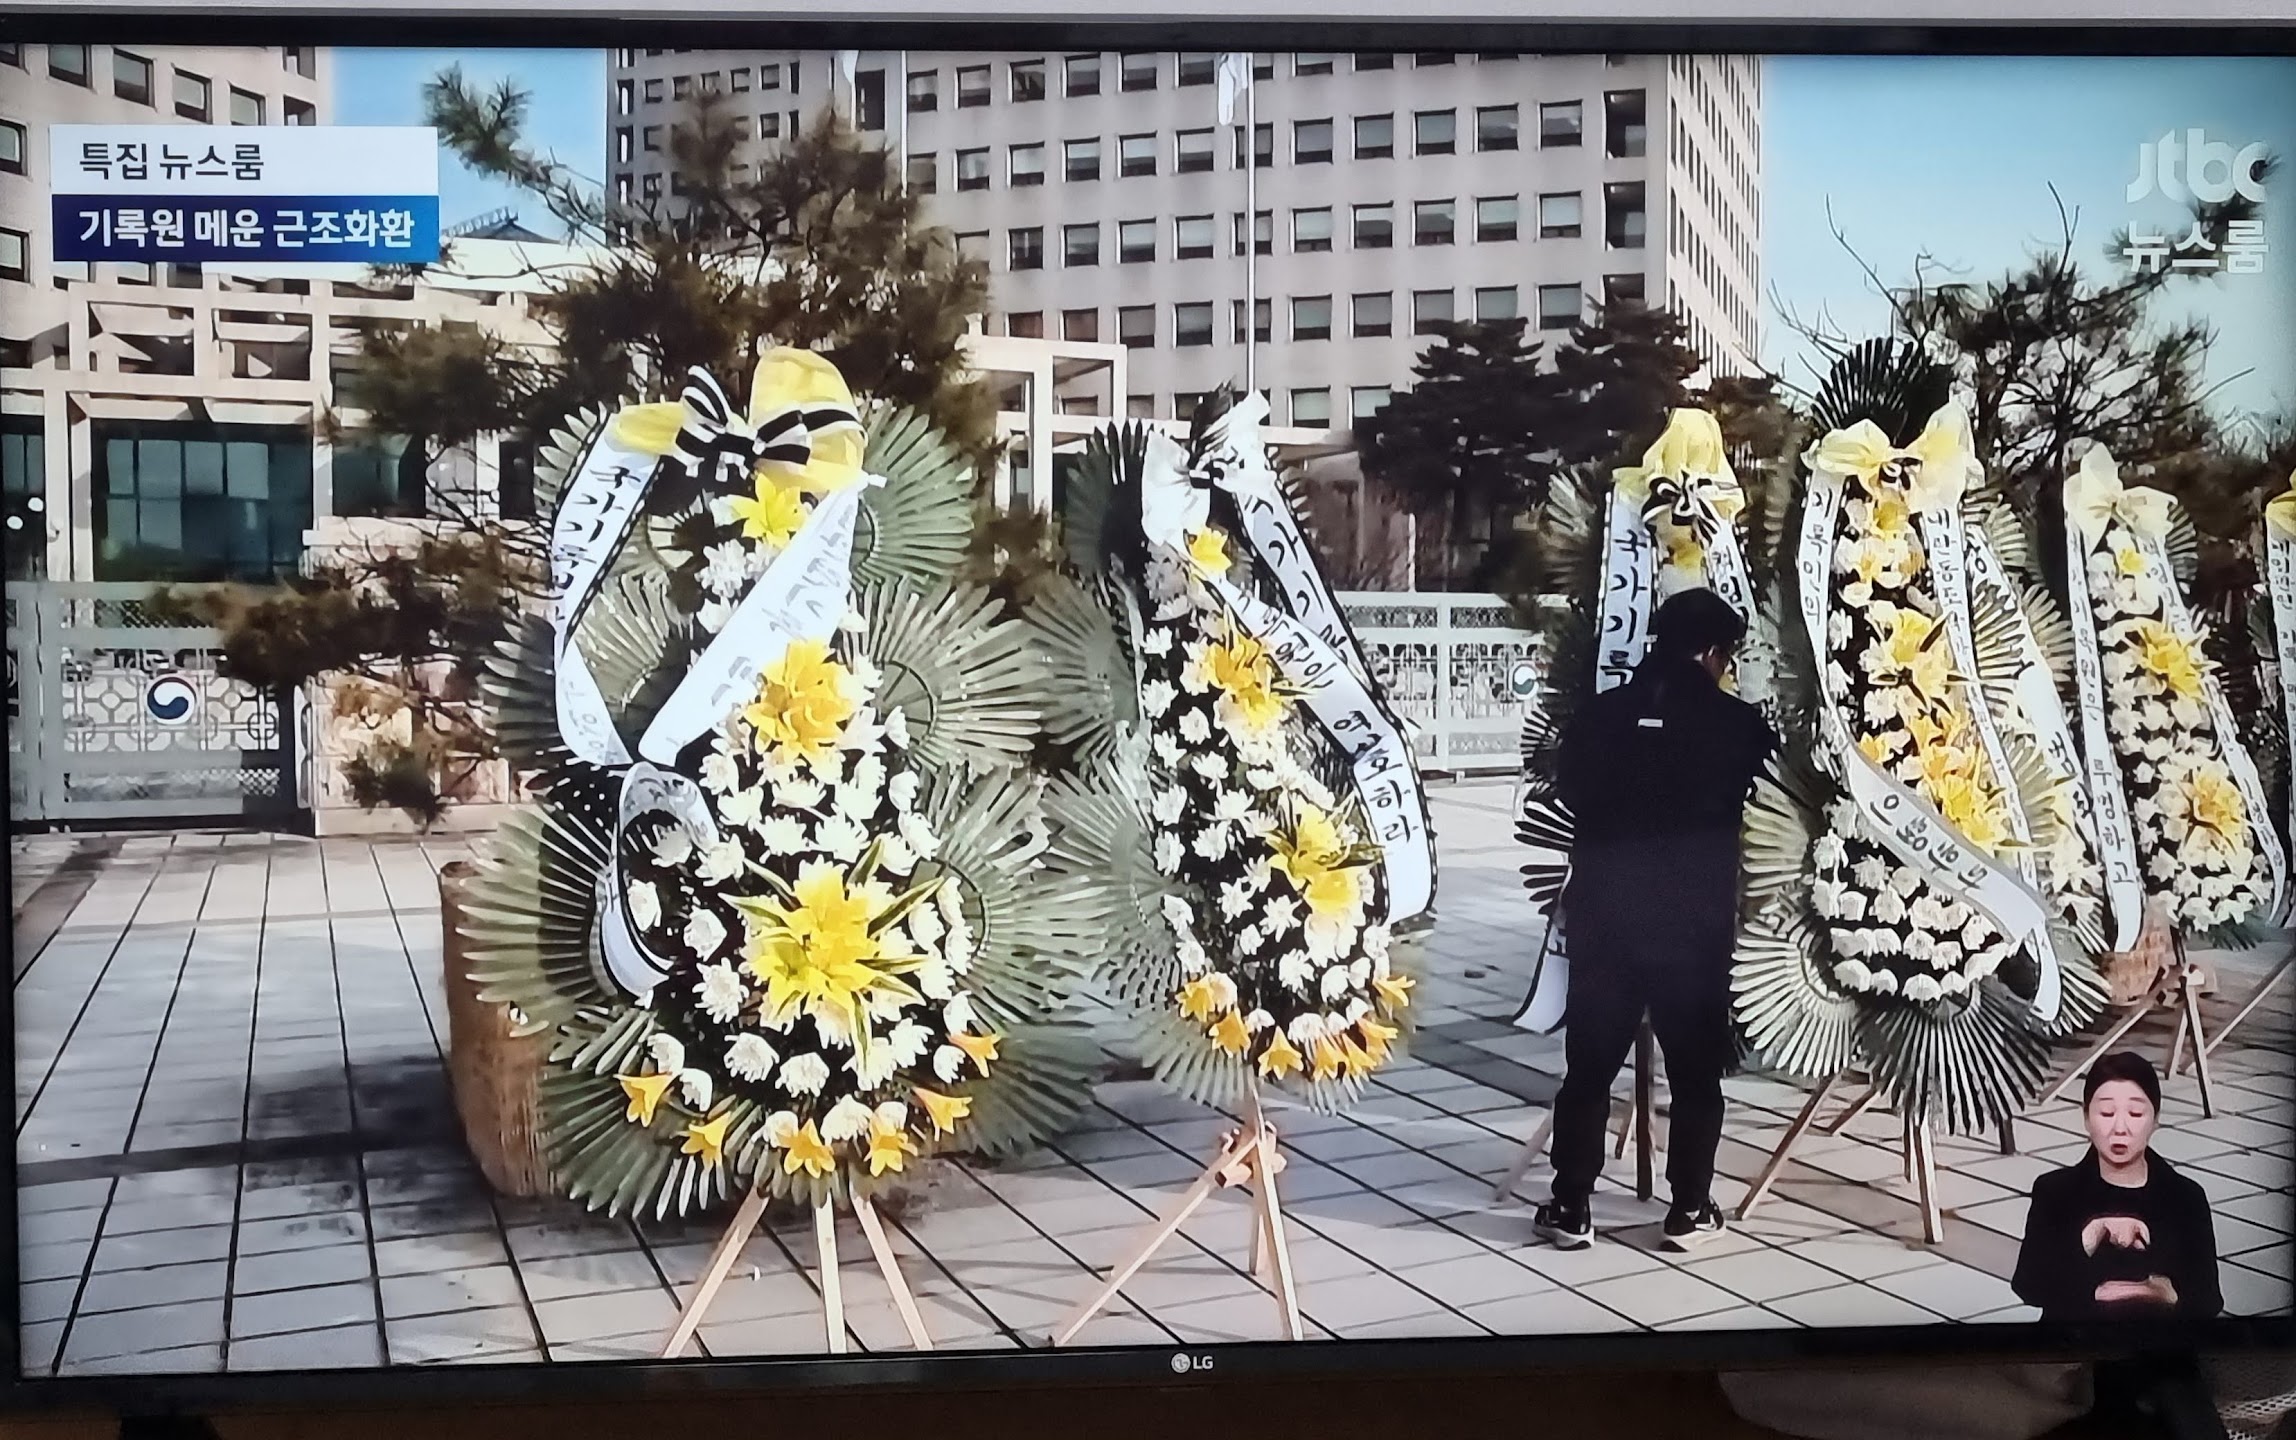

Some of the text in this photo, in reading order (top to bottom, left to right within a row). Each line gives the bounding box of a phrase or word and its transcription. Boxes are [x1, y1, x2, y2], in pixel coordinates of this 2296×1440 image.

[79, 143, 264, 180] 특집 뉴스룸
[79, 209, 415, 248] 기록원 메운 근조화환
[2122, 220, 2269, 273] 뉴스룸
[1193, 1356, 1213, 1369] LG
